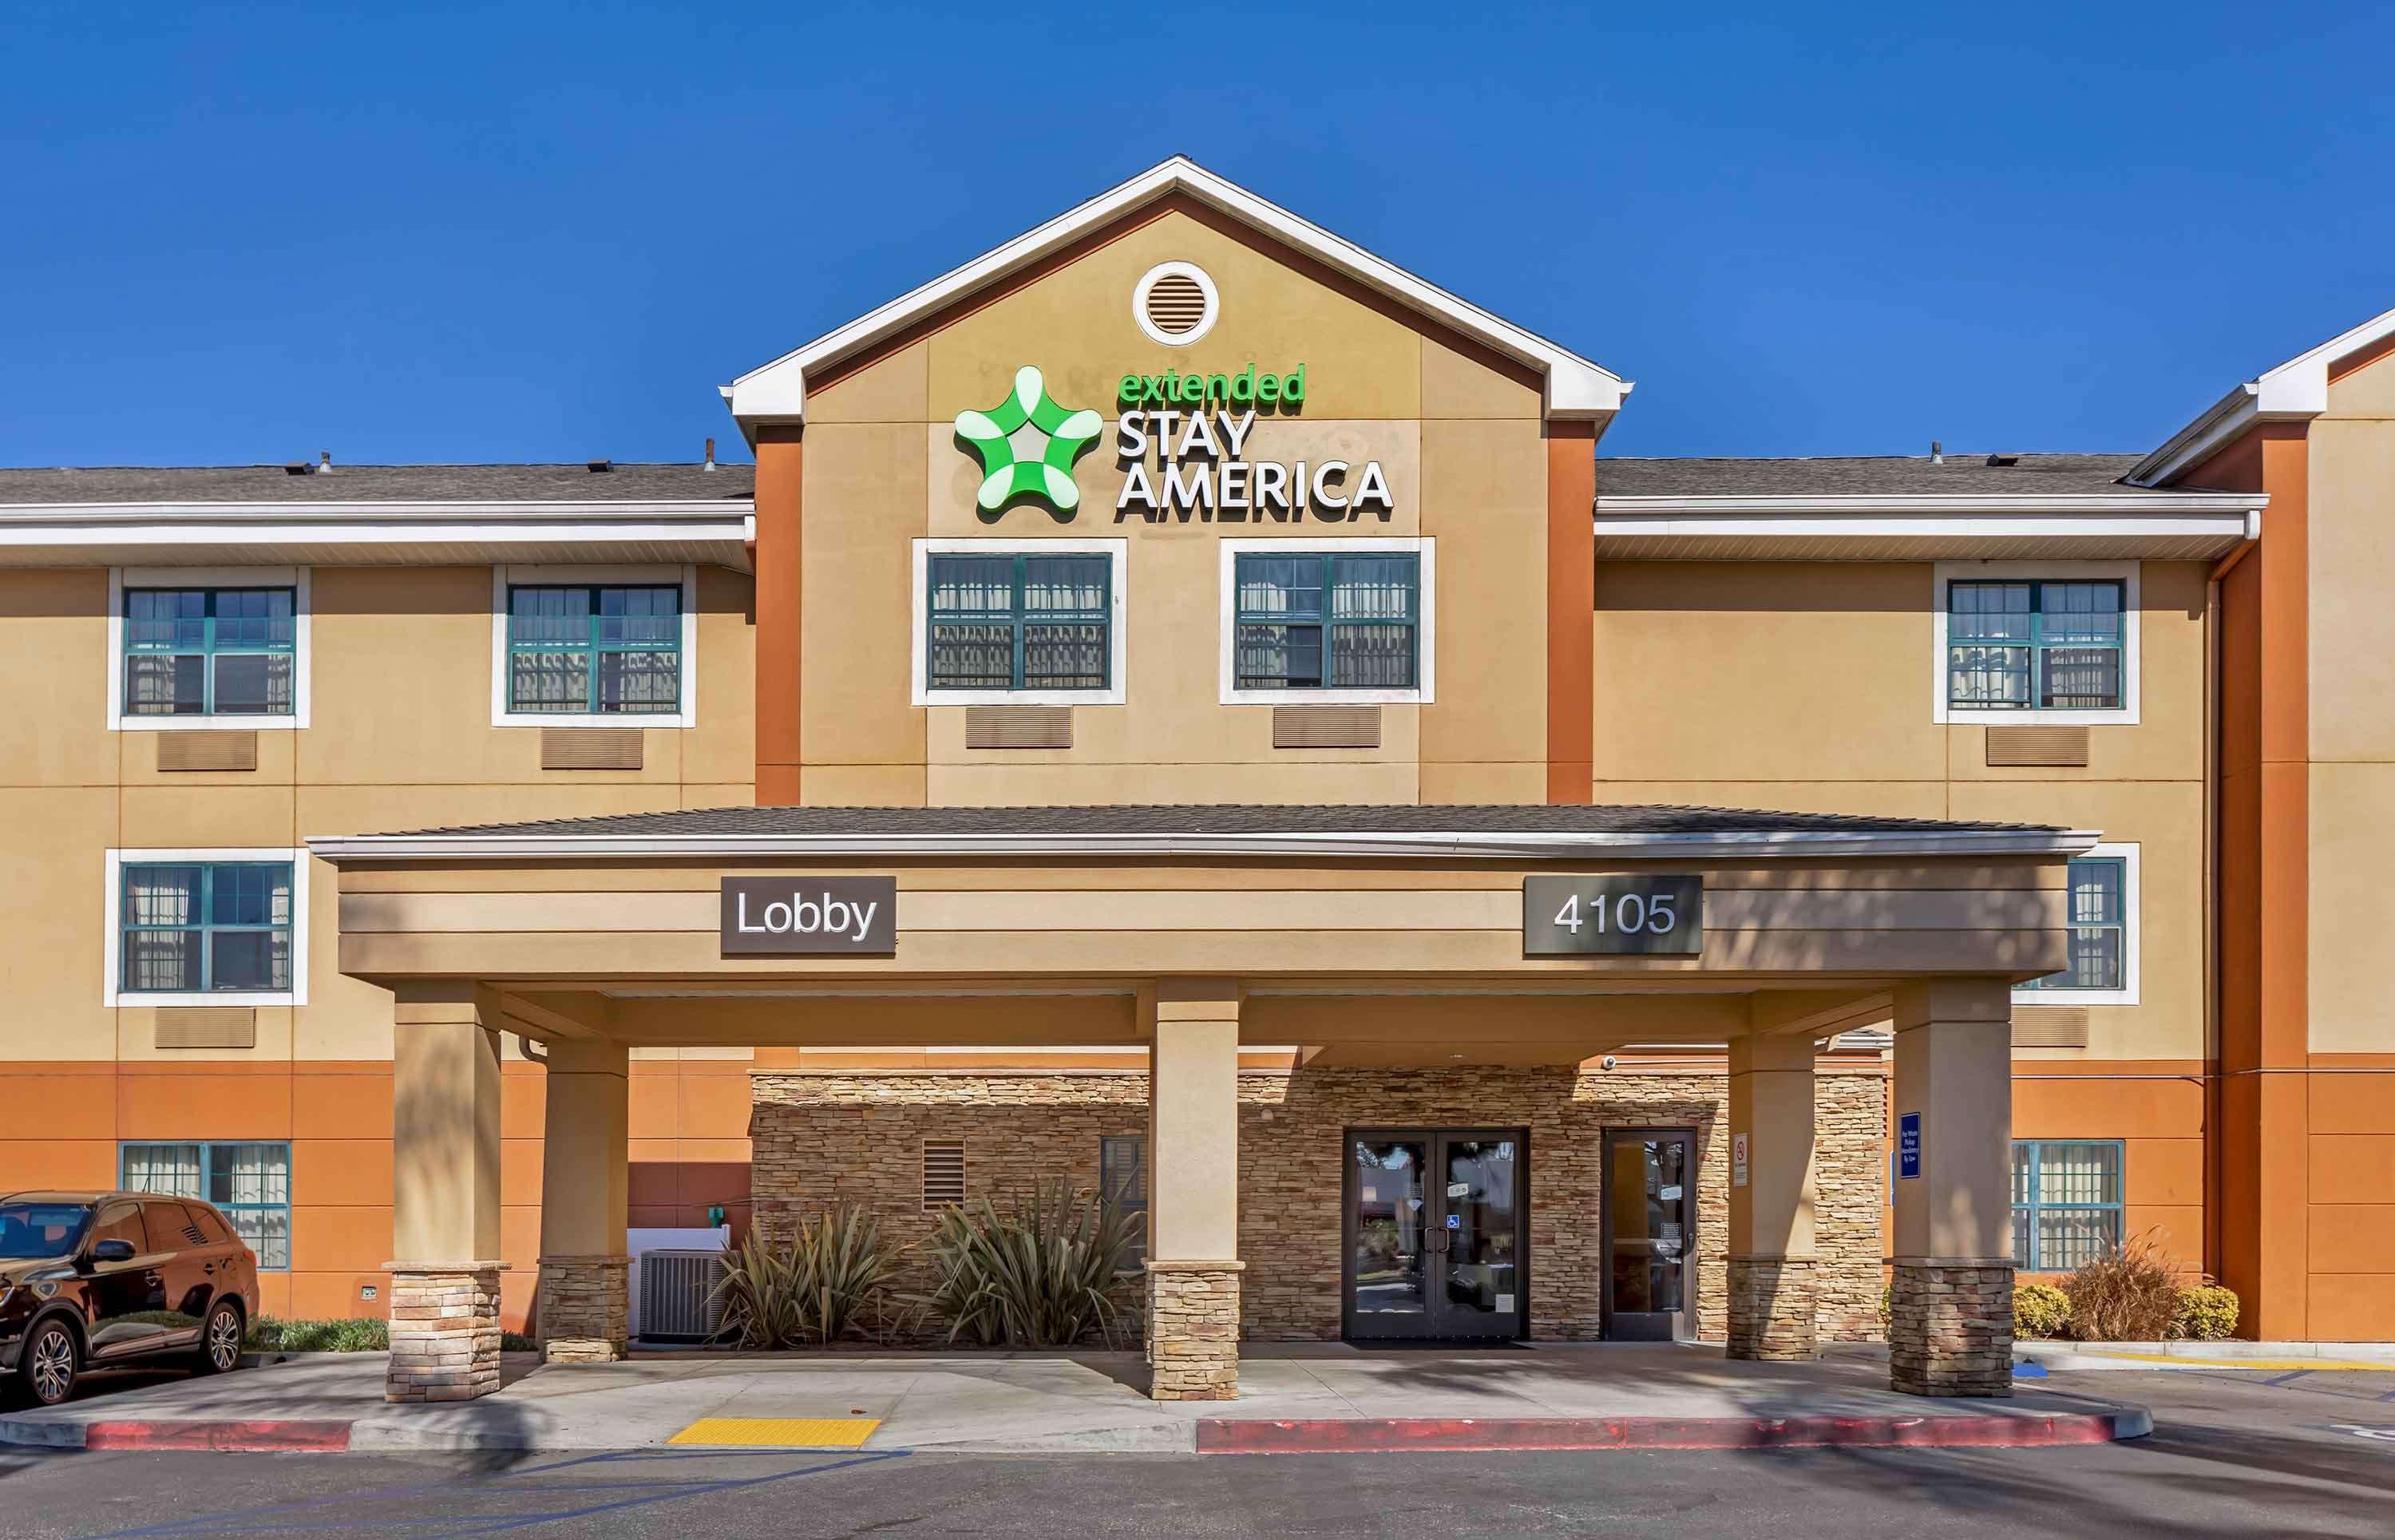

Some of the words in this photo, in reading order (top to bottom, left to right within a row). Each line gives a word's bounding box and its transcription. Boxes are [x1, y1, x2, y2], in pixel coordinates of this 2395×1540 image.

[1118, 363, 1307, 403] extended
[1118, 410, 1257, 457] STAY
[1117, 461, 1394, 509] AMERICA
[738, 892, 877, 942] Lobby
[1554, 893, 1675, 935] 4105
